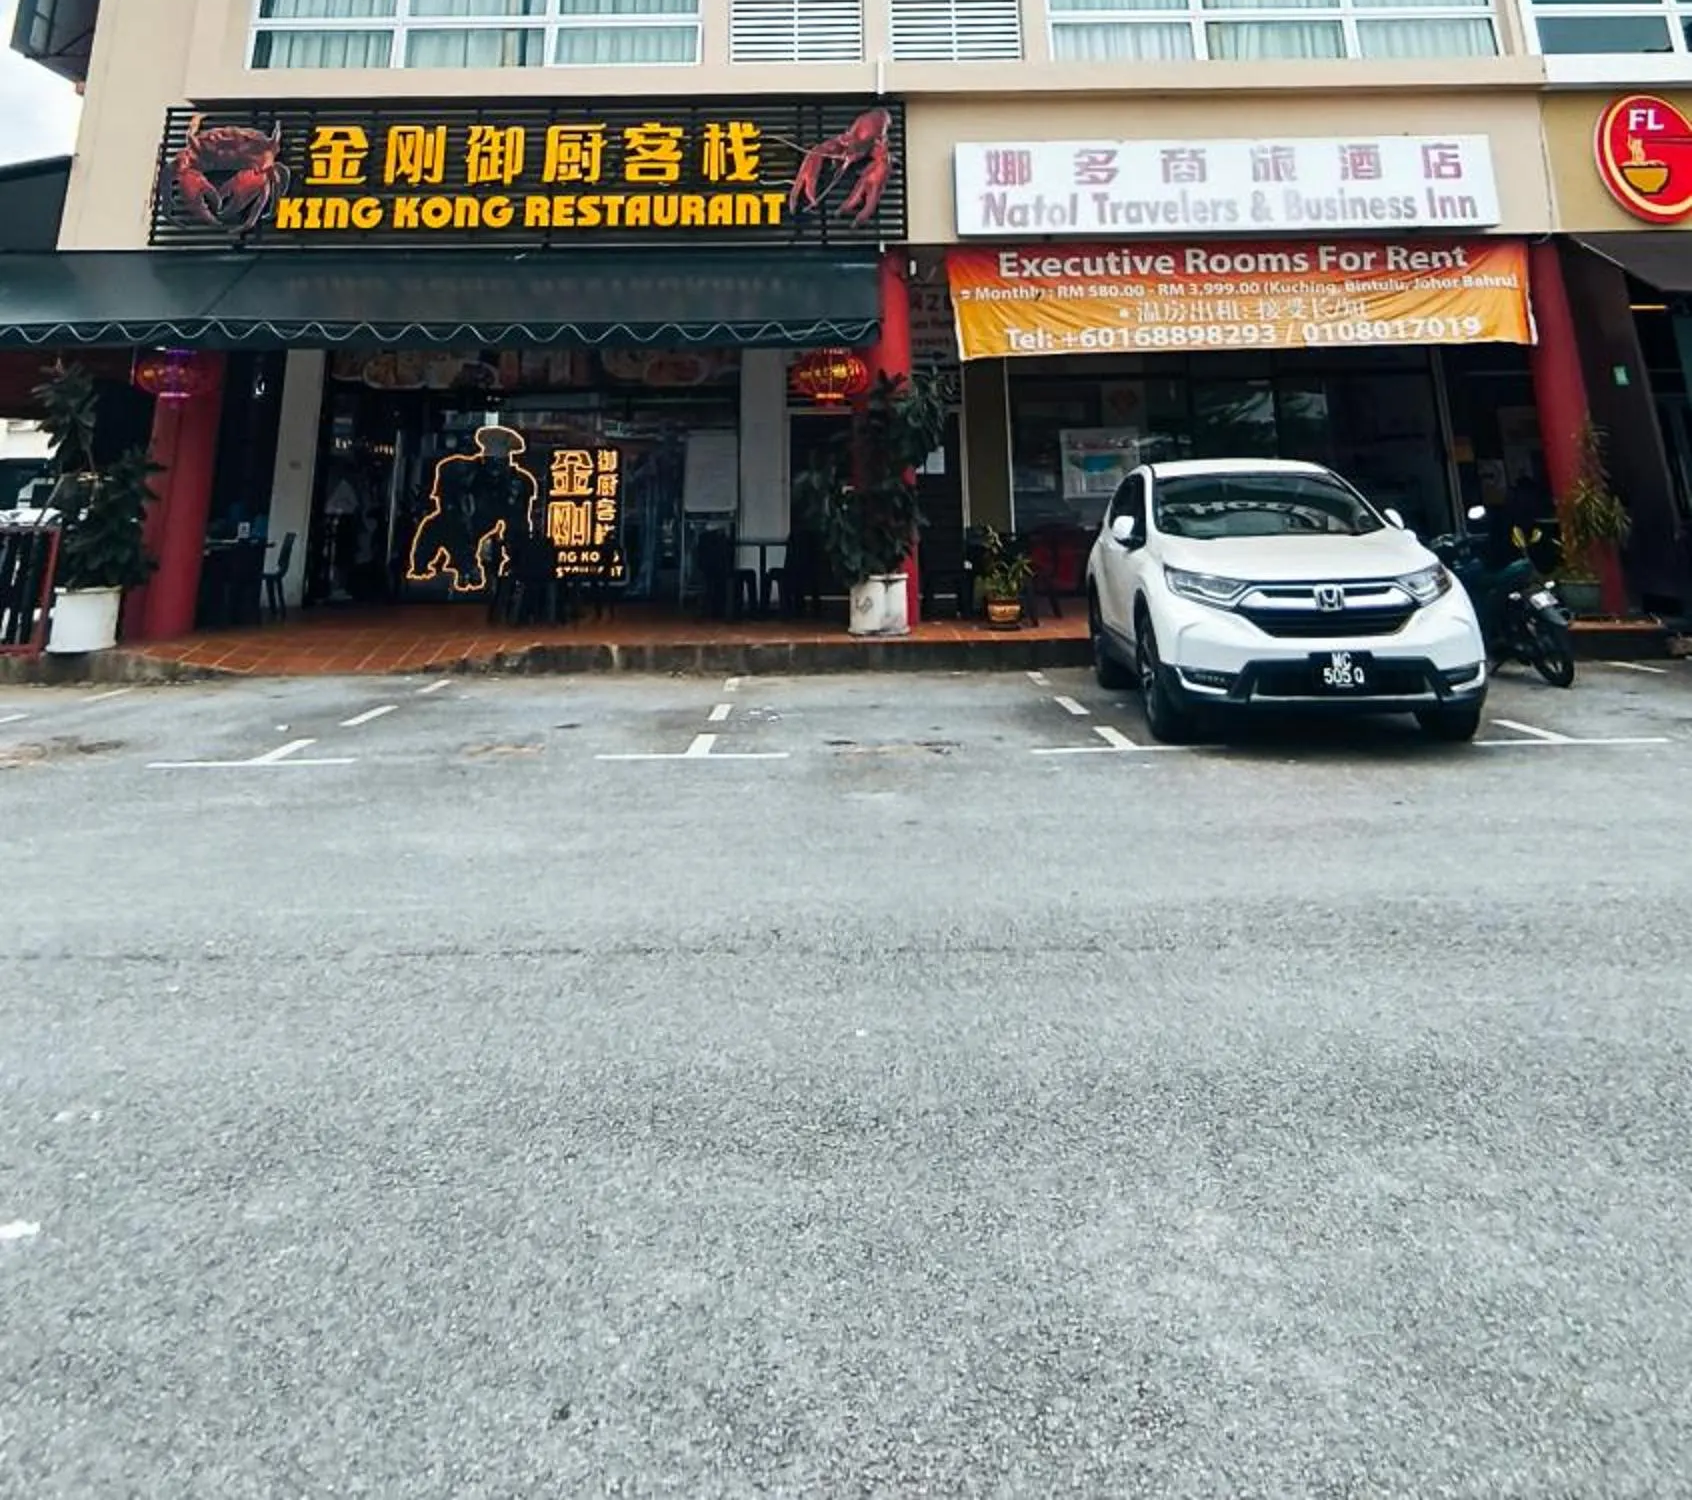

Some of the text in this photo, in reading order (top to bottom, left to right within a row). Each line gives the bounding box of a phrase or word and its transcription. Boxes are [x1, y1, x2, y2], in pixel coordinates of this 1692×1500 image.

[1628, 108, 1665, 131] FL
[305, 121, 762, 186] 金刚御厨客栈
[985, 143, 1463, 186] 娜多商旅酒店
[276, 193, 786, 229] KING KONG RESTAURANT
[981, 186, 1478, 228] Natol Travelers & Business Inn
[999, 245, 1468, 278] Executive Rooms For Rent
[1057, 284, 1084, 298] RM
[1158, 282, 1184, 296] RM
